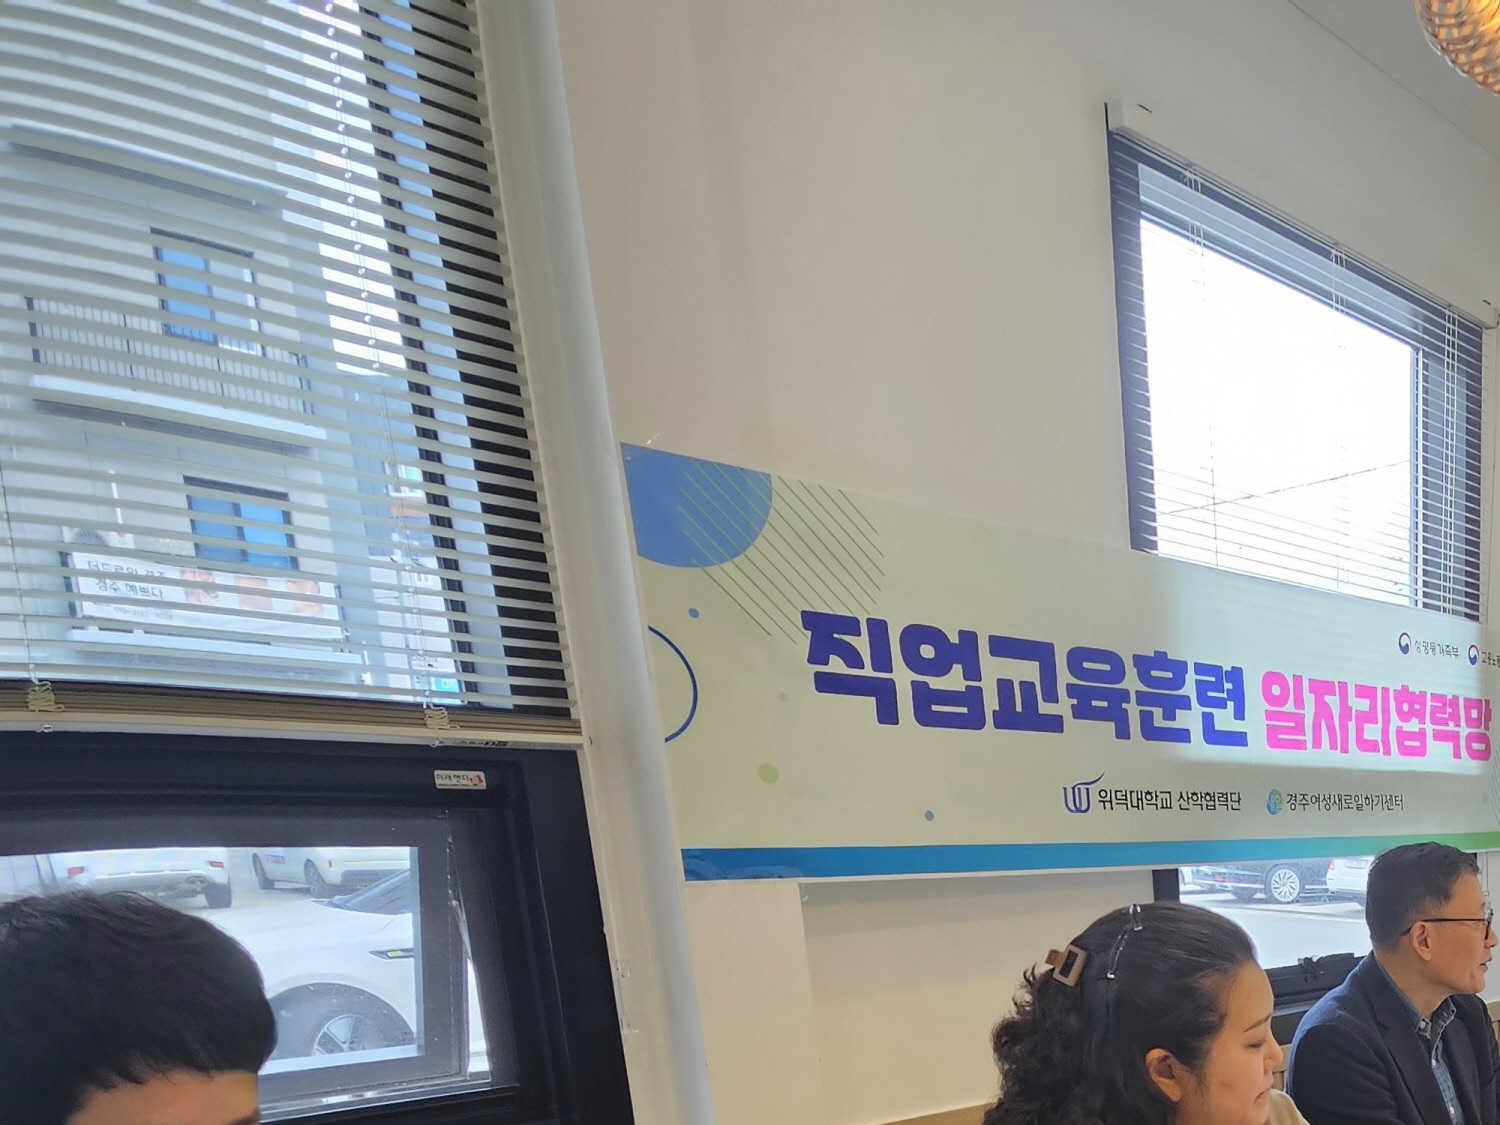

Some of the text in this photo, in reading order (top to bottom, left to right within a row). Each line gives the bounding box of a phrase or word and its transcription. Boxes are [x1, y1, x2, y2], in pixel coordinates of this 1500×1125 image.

[125, 583, 163, 600] 예쁘다
[1414, 640, 1460, 658] 성평등가족부
[801, 610, 1493, 761] 직업교육훈련 일자리협력망
[1098, 789, 1242, 811] 위덕대학교 산학협력단
[1286, 792, 1404, 811] 경주여성새로일하기센터
